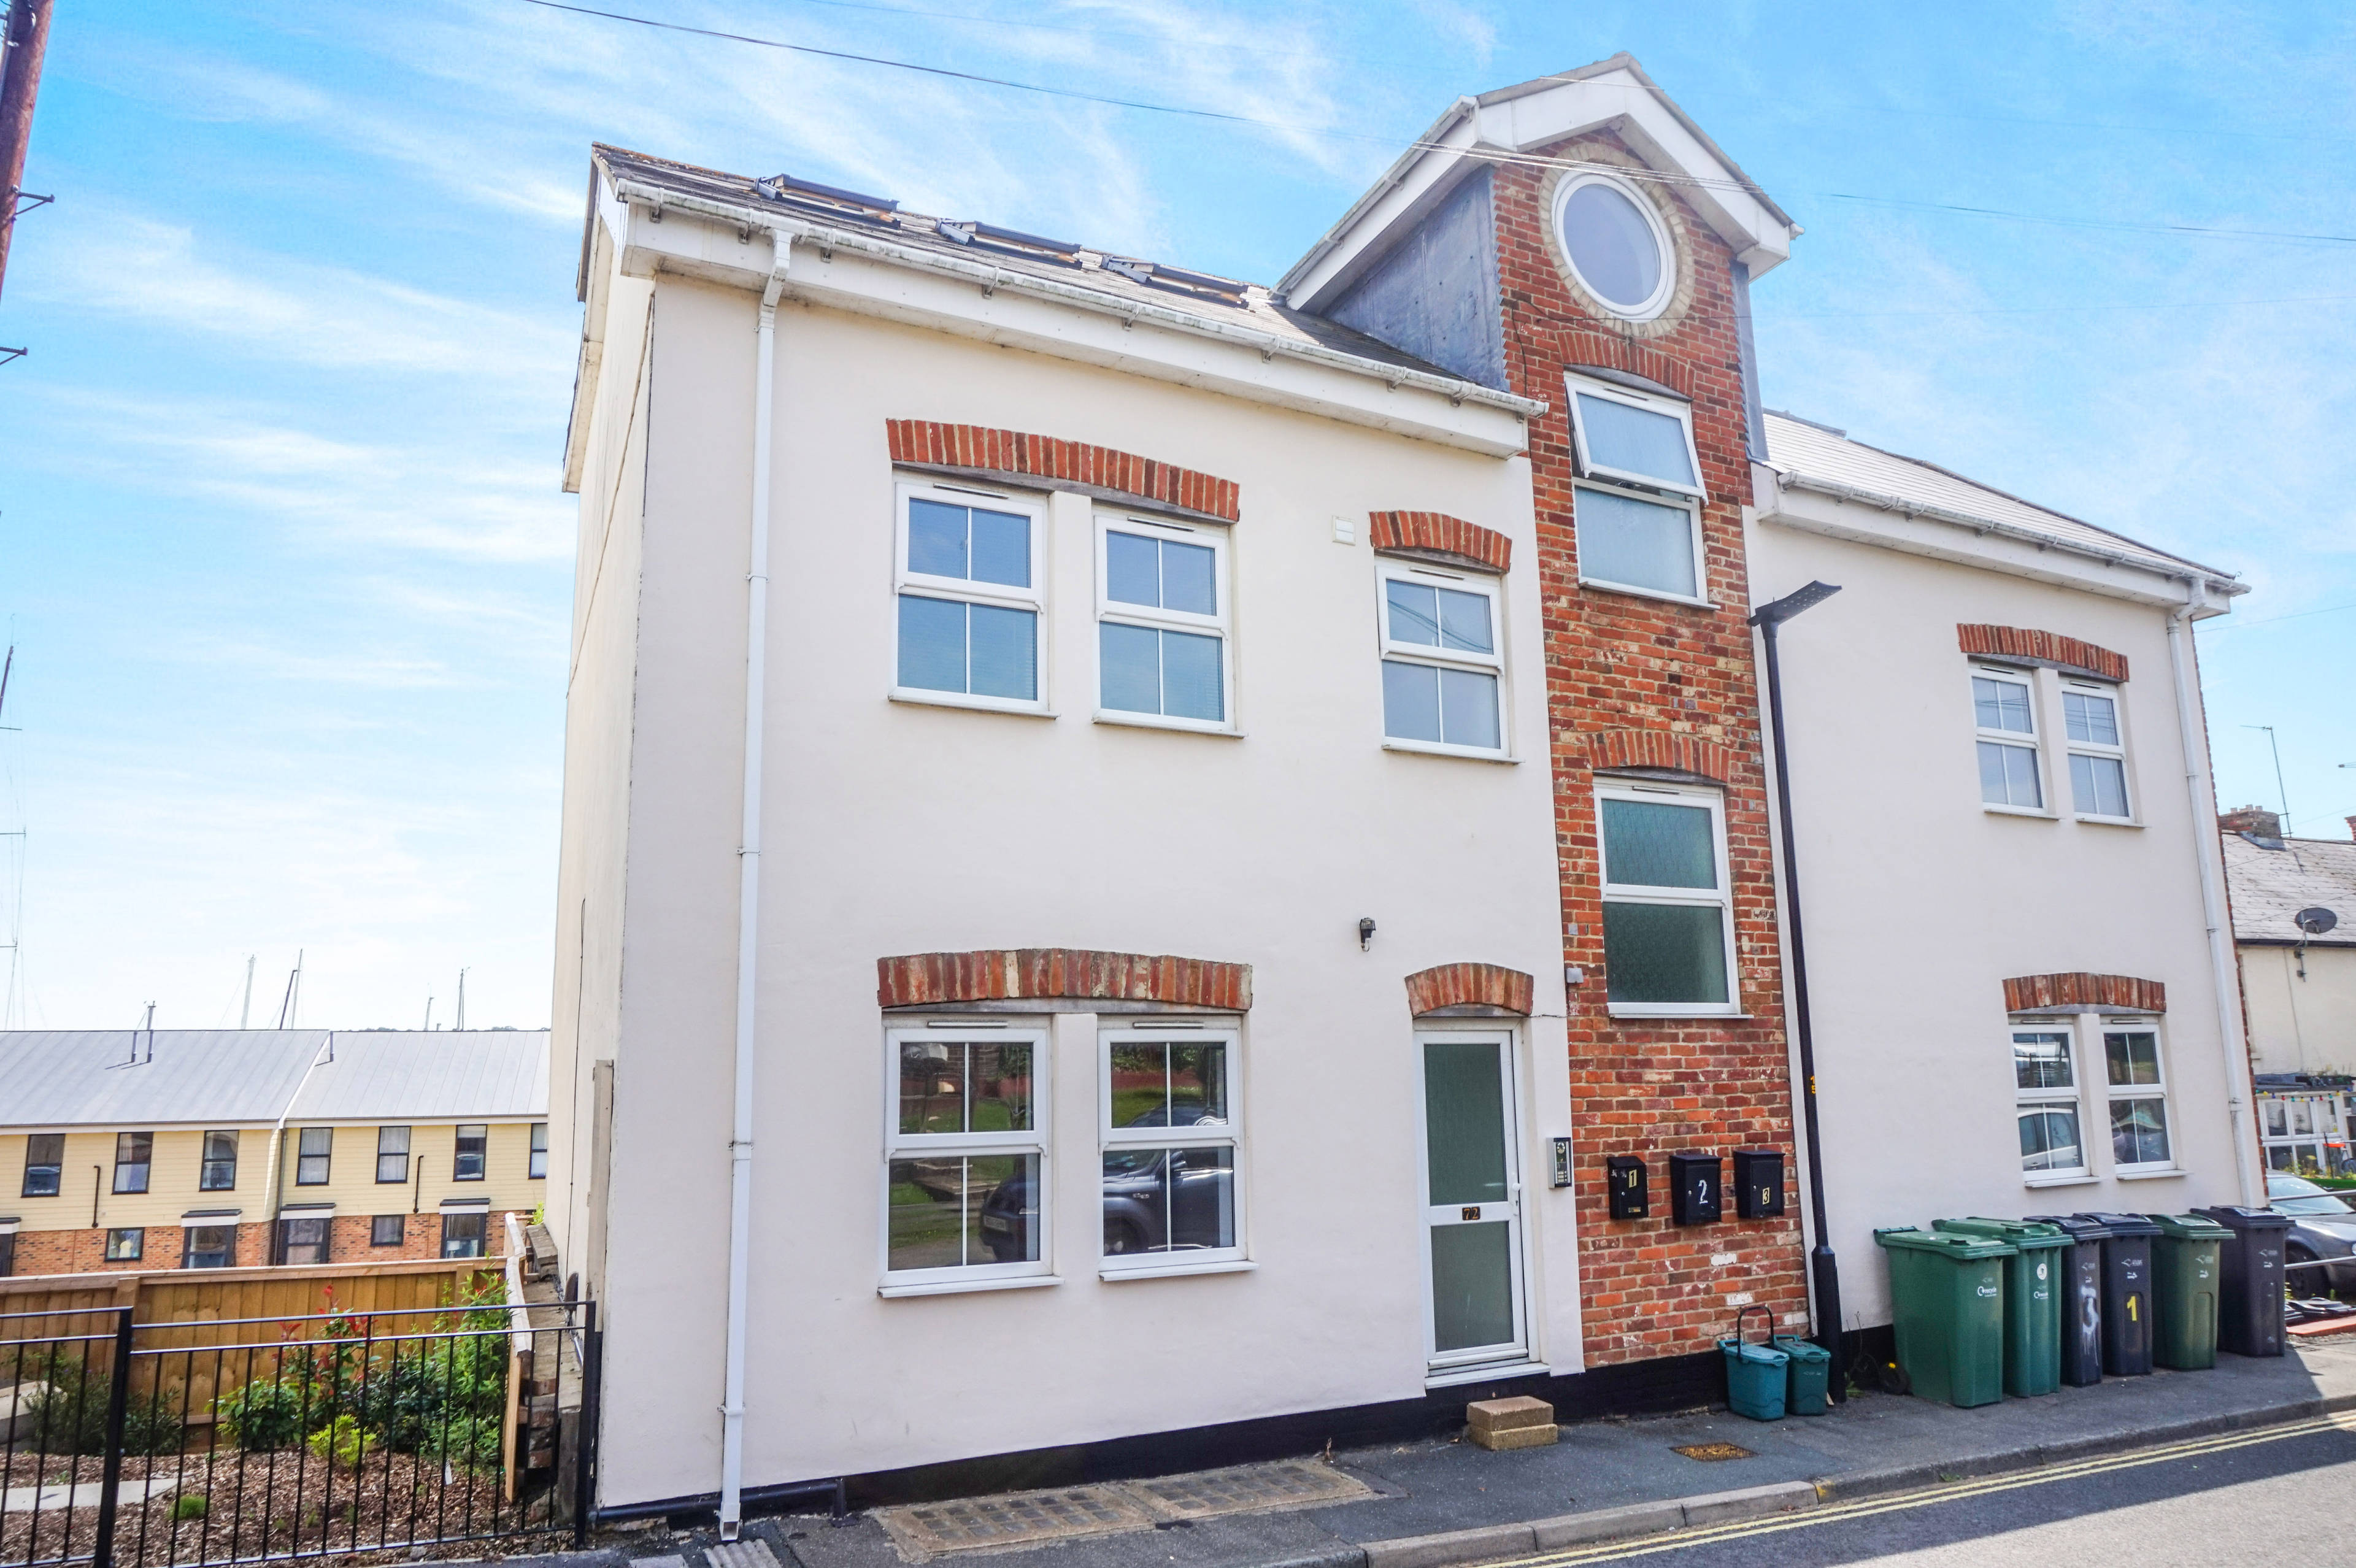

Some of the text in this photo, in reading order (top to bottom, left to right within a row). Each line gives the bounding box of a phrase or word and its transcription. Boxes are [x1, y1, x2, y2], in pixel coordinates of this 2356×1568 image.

[1630, 1170, 1635, 1186] 1
[1698, 1179, 1708, 1204] 2
[1763, 1189, 1769, 1203] 3
[1464, 1207, 1478, 1220] 72
[2127, 1296, 2138, 1321] 1
